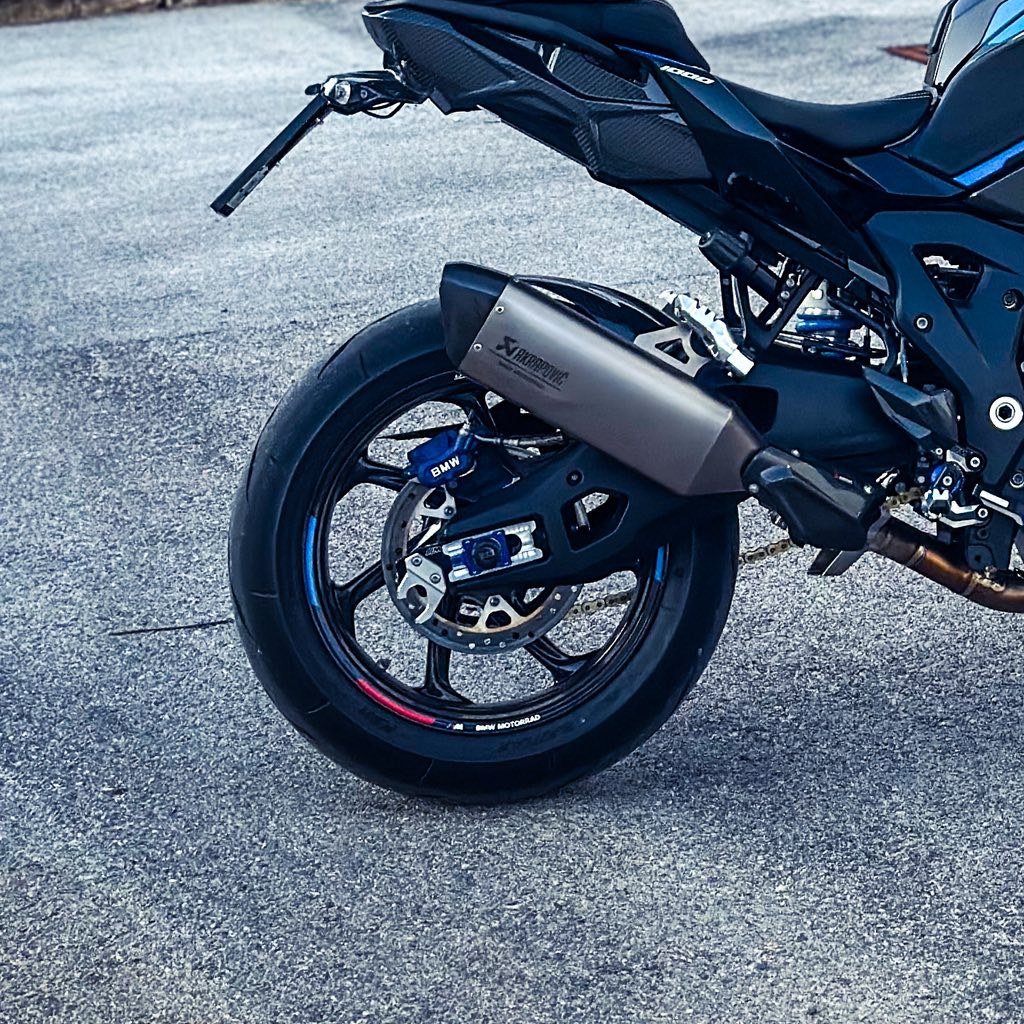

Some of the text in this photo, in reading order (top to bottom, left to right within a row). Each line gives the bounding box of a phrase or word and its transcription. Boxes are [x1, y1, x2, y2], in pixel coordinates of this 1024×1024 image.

[660, 65, 715, 85] 1000
[430, 456, 460, 477] BMW
[497, 714, 541, 730] MOTORRAD
